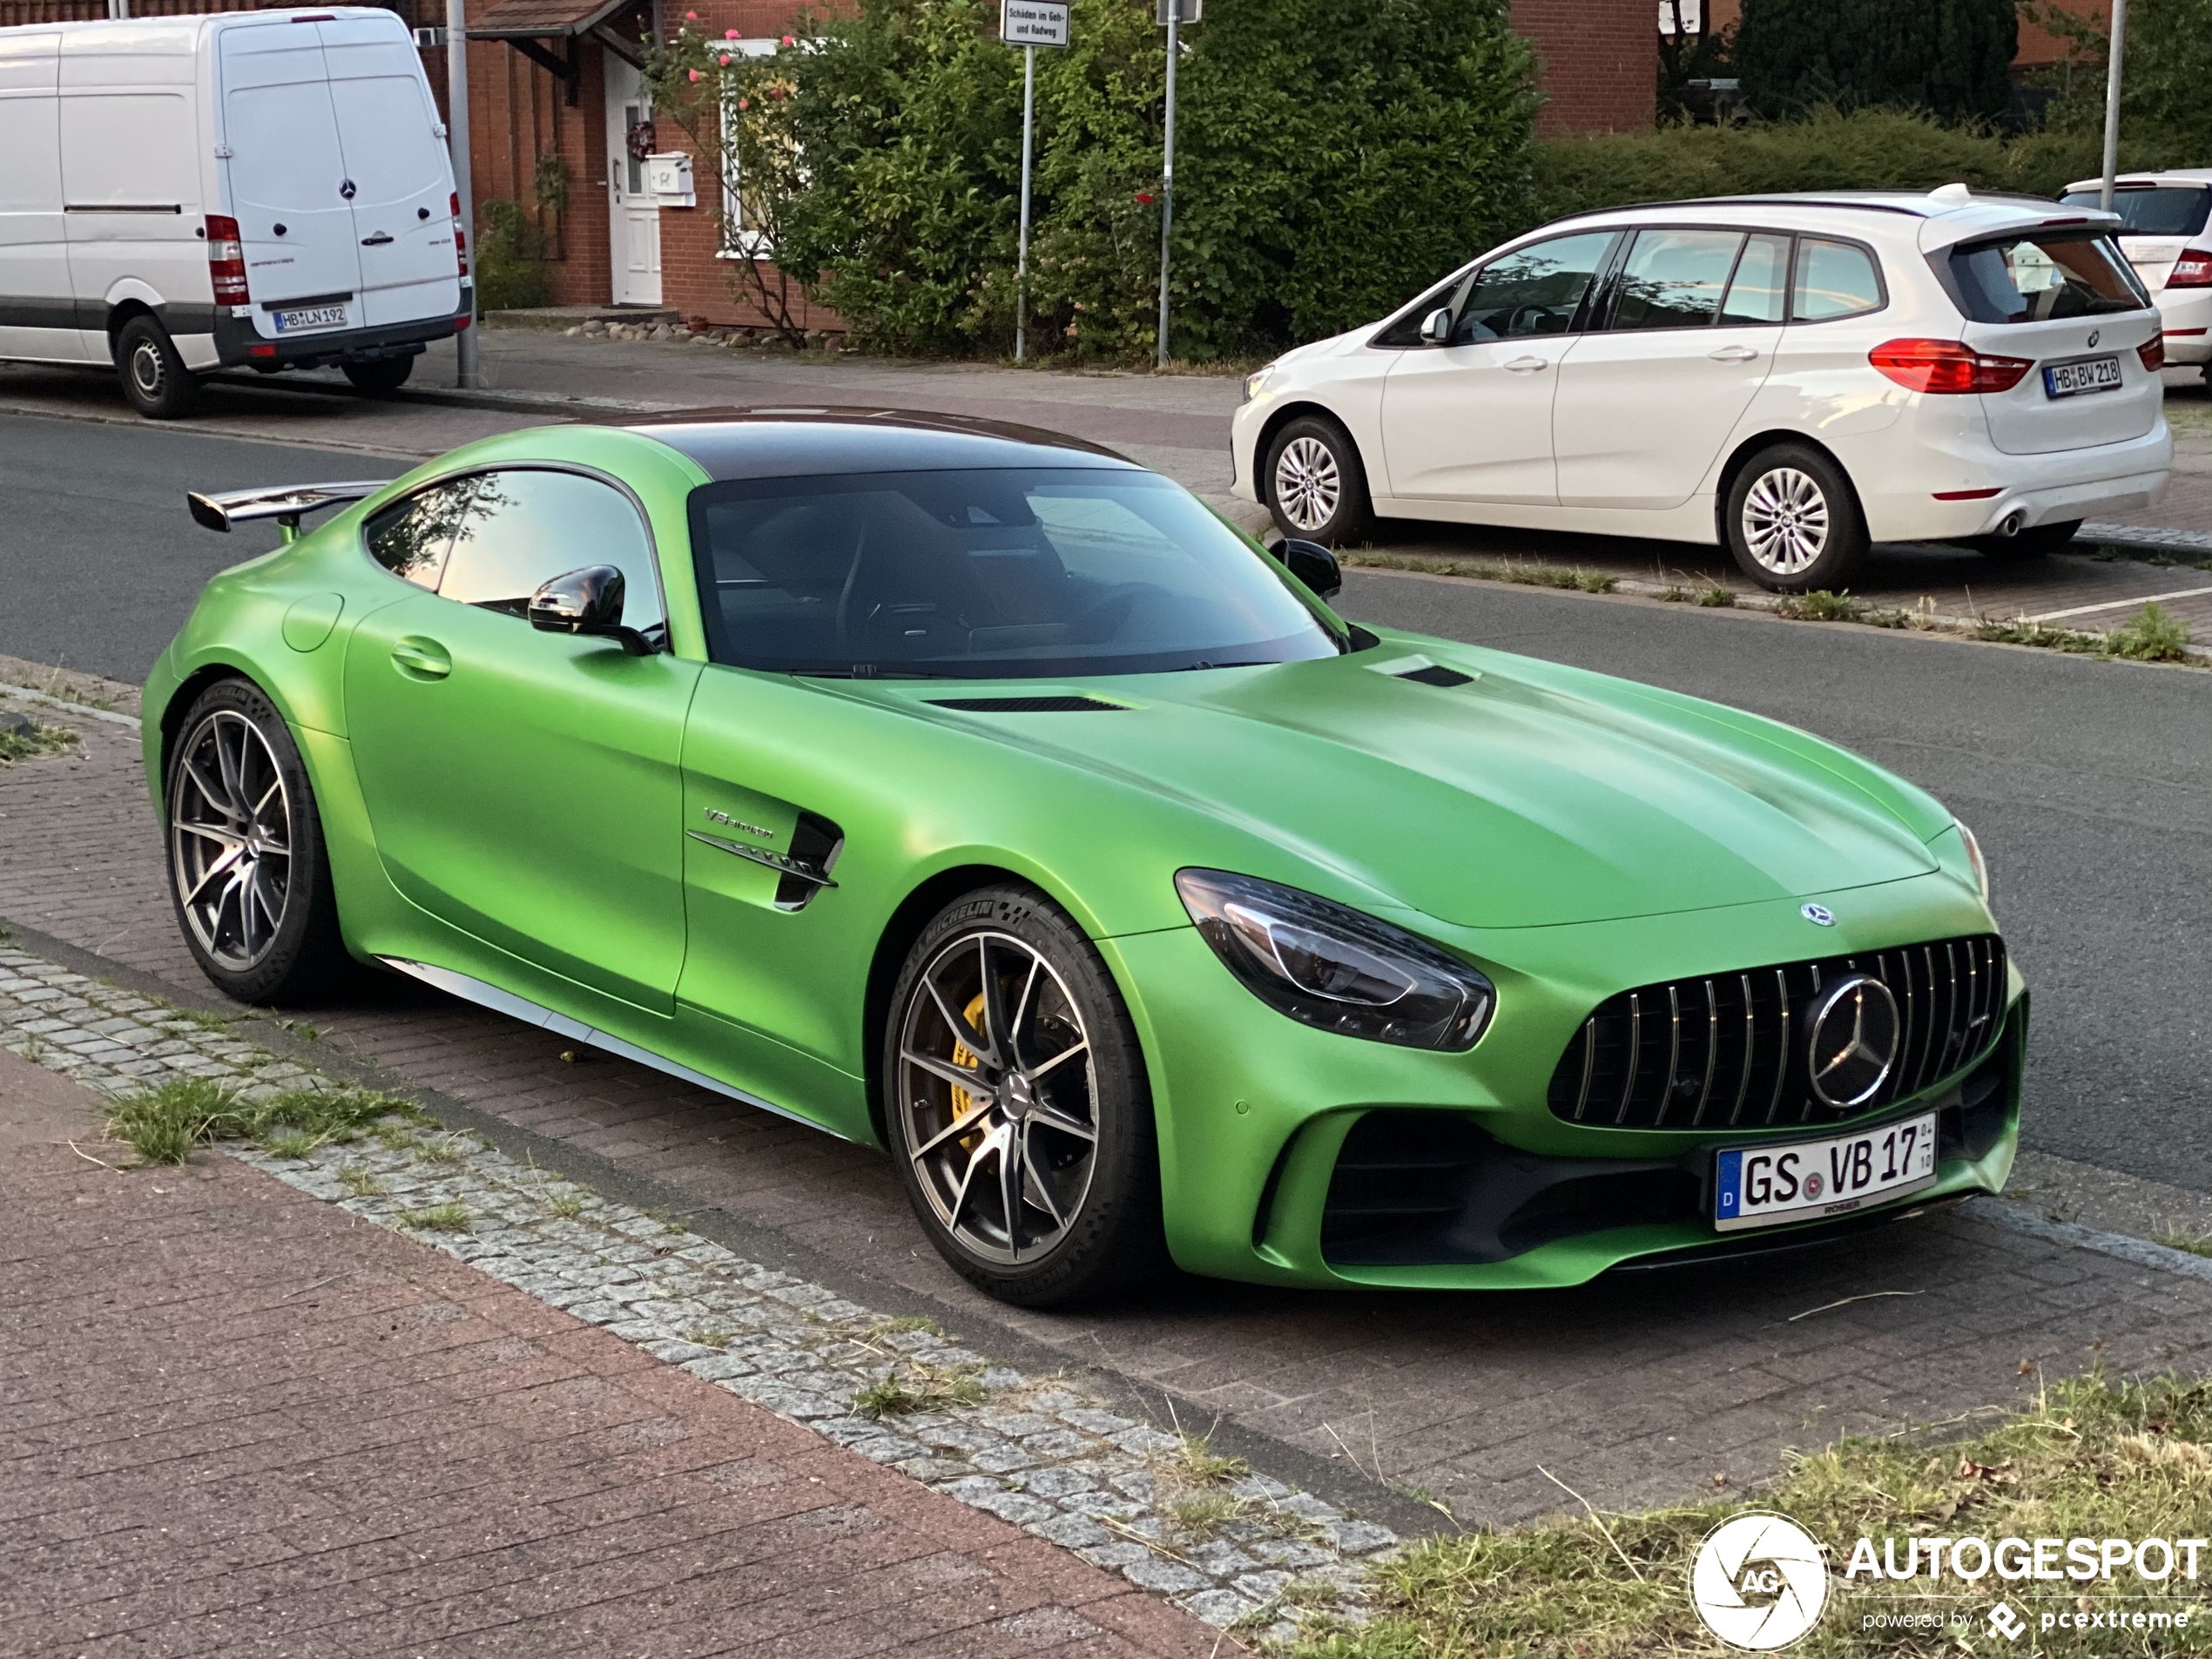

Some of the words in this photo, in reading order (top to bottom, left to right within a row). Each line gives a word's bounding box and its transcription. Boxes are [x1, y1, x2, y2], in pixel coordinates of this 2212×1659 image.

[1009, 8, 1036, 19] Schäden
[1039, 10, 1047, 21] im
[1049, 11, 1064, 22] Geh-
[1017, 24, 1028, 34] und
[1031, 24, 1056, 38] Radweg
[282, 314, 299, 327] HB
[305, 312, 322, 324] LN
[323, 308, 344, 322] 192
[2054, 369, 2071, 389] HB
[2078, 366, 2094, 386] BW
[2096, 362, 2118, 383] 218
[704, 807, 729, 826] V8
[730, 819, 773, 840] BITURBO
[925, 900, 994, 945] MICHELIN
[1723, 1192, 1733, 1206] D
[1745, 1153, 1800, 1205] GS
[1831, 1139, 1872, 1193] VB
[1881, 1125, 1918, 1182] 17
[1824, 1201, 1860, 1215] ROSIER
